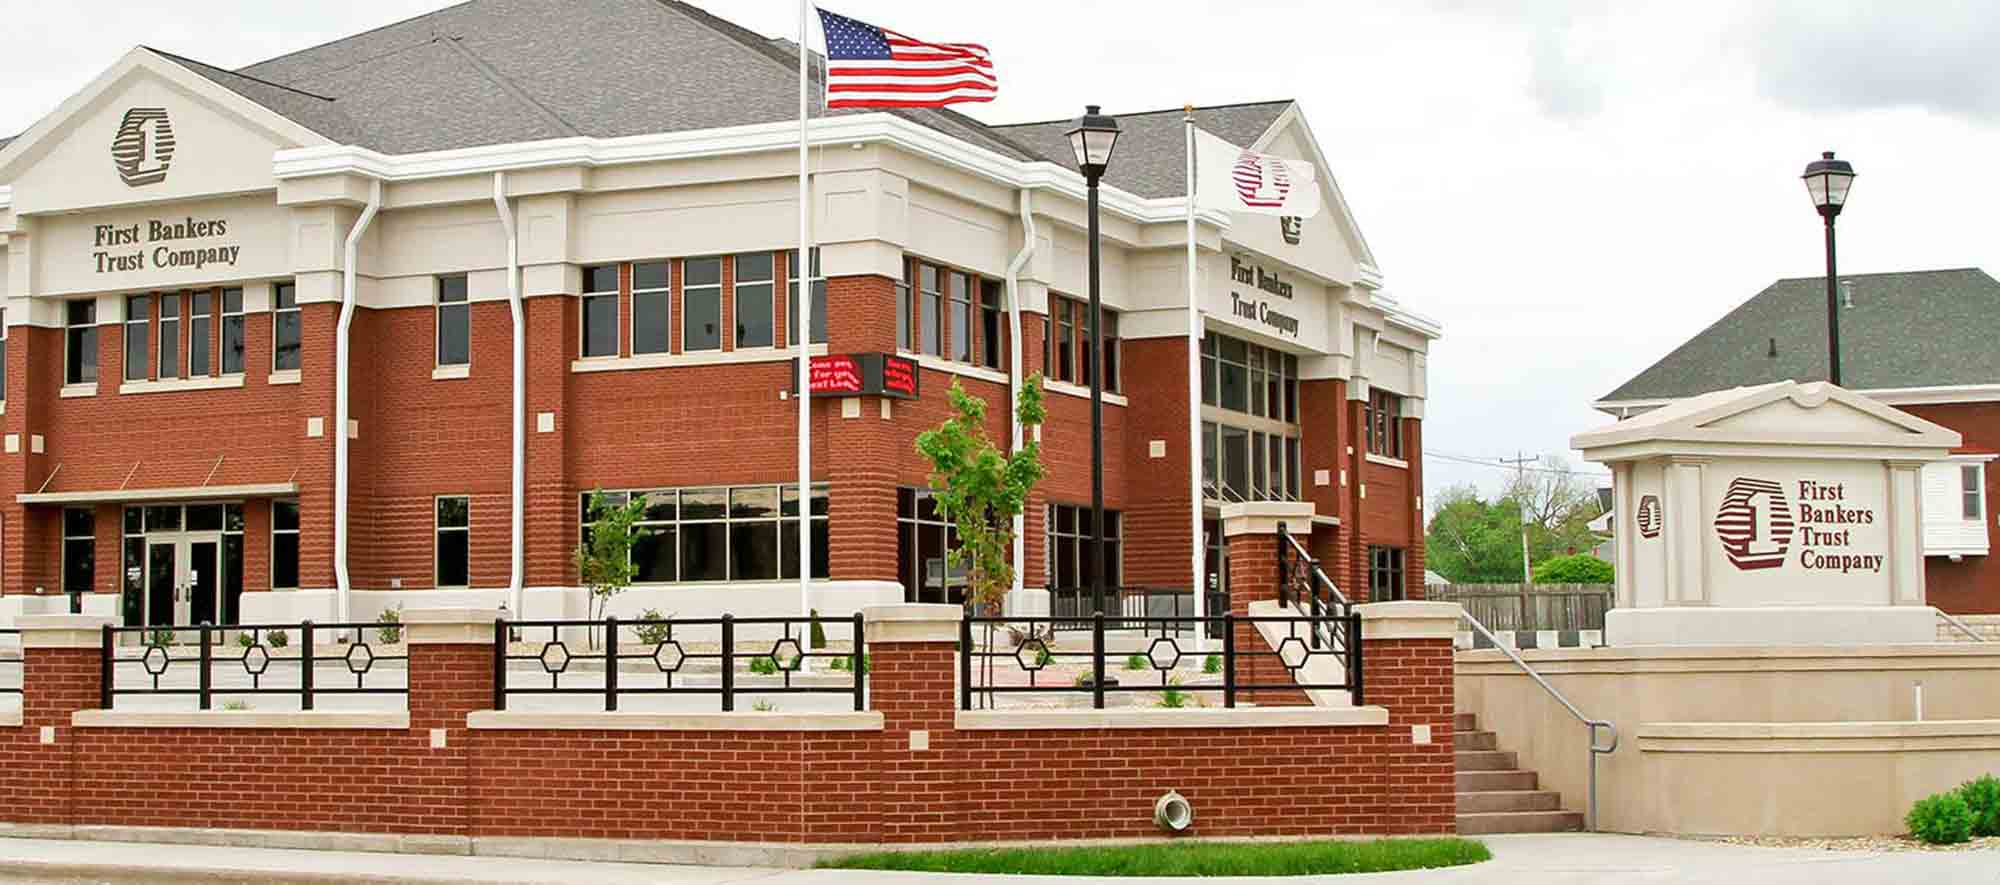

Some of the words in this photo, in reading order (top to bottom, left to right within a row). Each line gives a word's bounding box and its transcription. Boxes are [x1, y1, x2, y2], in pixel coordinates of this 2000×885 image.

[94, 223, 139, 247] First
[148, 217, 227, 242] Bankers
[93, 251, 144, 273] Trust
[152, 245, 240, 269] Company
[1231, 256, 1254, 286] First
[1257, 266, 1293, 299] Bankers
[1231, 291, 1256, 320] Trust
[1260, 302, 1299, 337] Company
[1799, 480, 1843, 501] First
[1800, 504, 1873, 524] Bankers
[1800, 527, 1849, 546] Trust
[1800, 550, 1884, 573] Company
